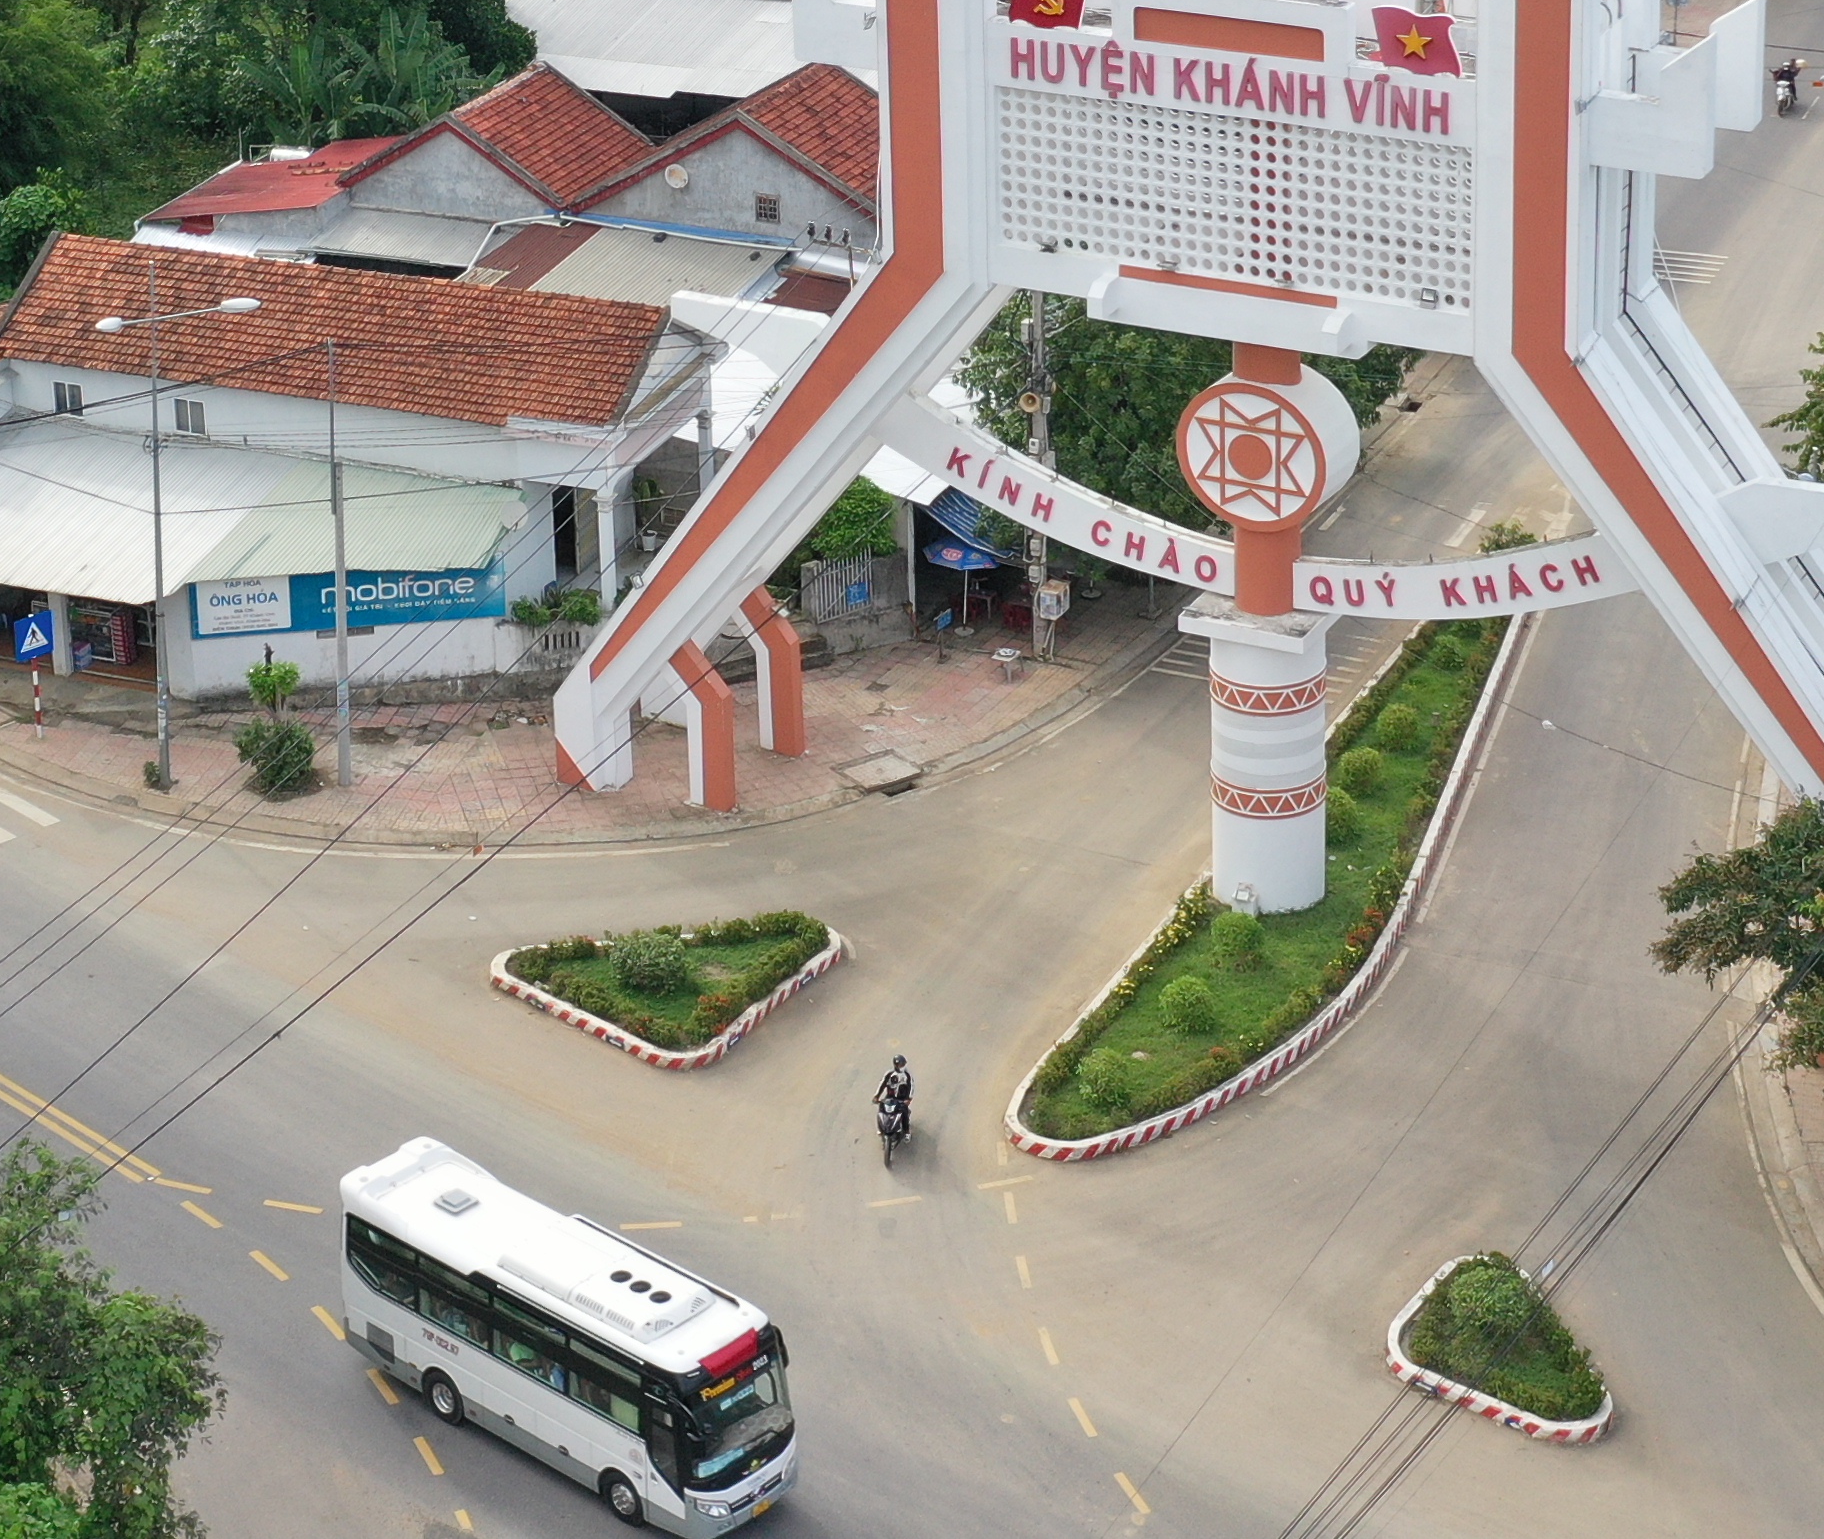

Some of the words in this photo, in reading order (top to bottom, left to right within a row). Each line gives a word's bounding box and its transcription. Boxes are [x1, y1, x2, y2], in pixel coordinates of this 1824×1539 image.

[1010, 37, 1156, 99] HUYỆN
[1173, 56, 1326, 119] KHÁNH
[1344, 73, 1451, 136] VĨNH
[946, 446, 1054, 523] KÍNH
[1091, 519, 1218, 583] CHÀO
[1309, 571, 1396, 607] QUÝ
[1439, 554, 1601, 608] KHÁCH
[209, 592, 242, 607] ÔNG
[246, 588, 279, 605] HÓA
[321, 574, 475, 605] mobifone
